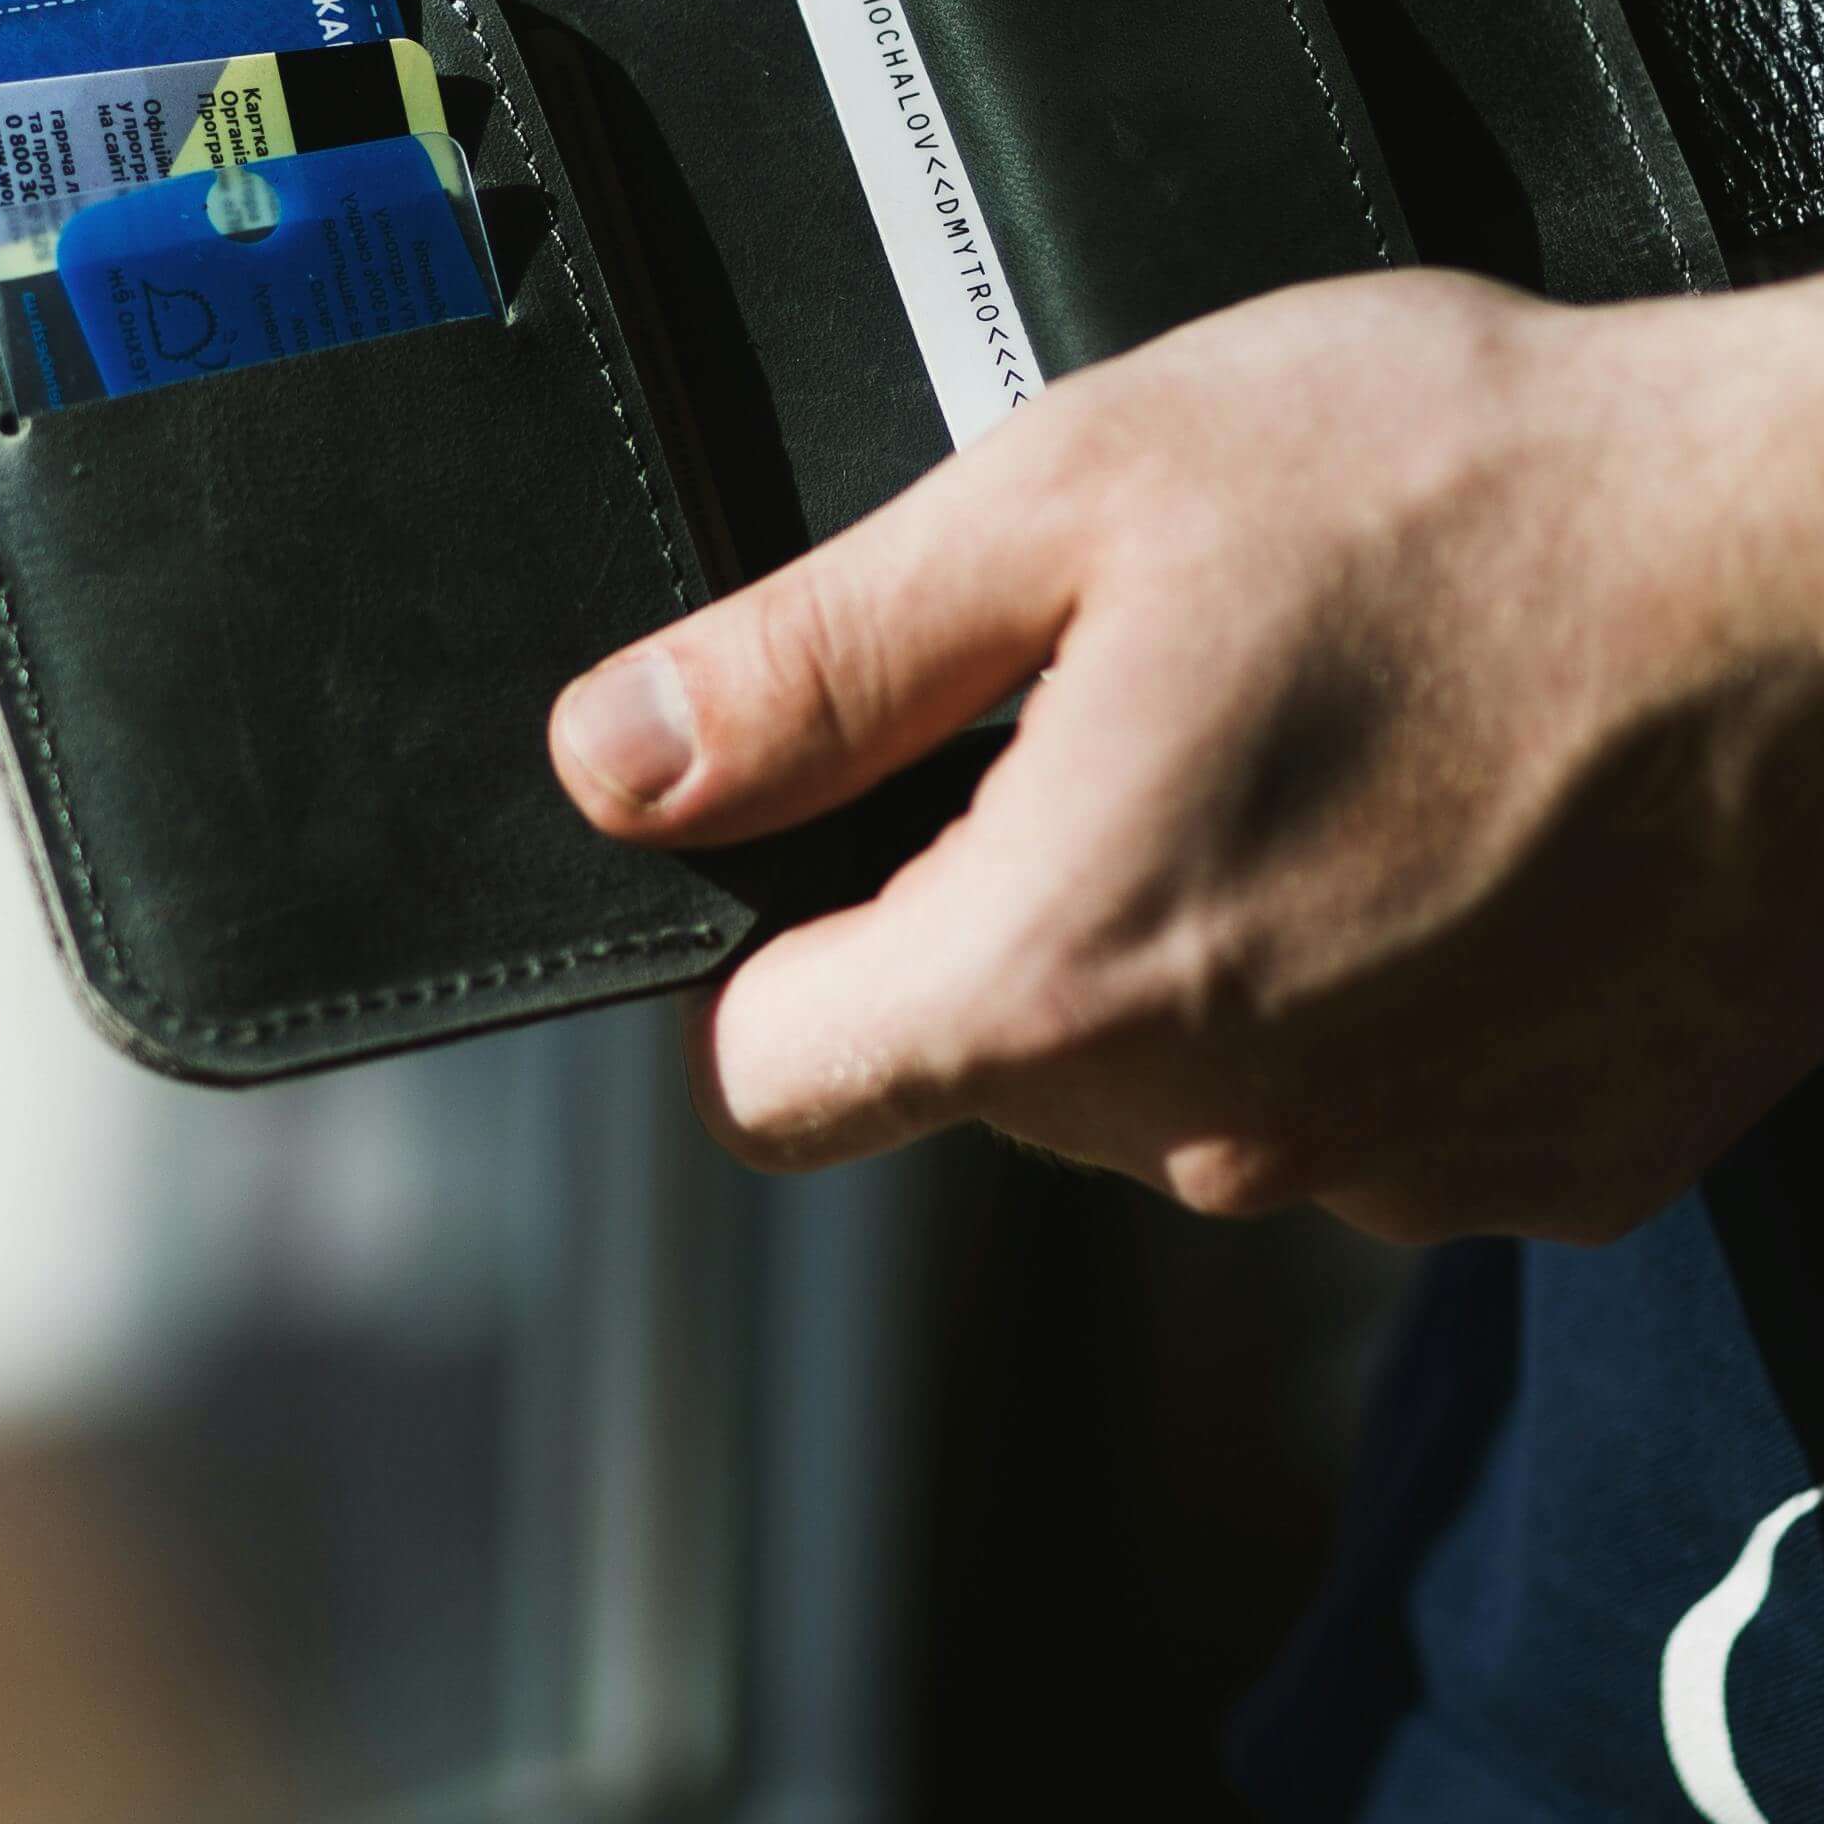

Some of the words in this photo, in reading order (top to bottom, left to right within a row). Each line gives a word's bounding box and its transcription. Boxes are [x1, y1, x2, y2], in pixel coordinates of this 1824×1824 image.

[29, 112, 44, 133] та
[98, 104, 114, 128] на
[243, 87, 269, 157] Картка
[10, 134, 33, 175] 800
[51, 110, 76, 176] гаряча
[104, 132, 130, 182] сайті
